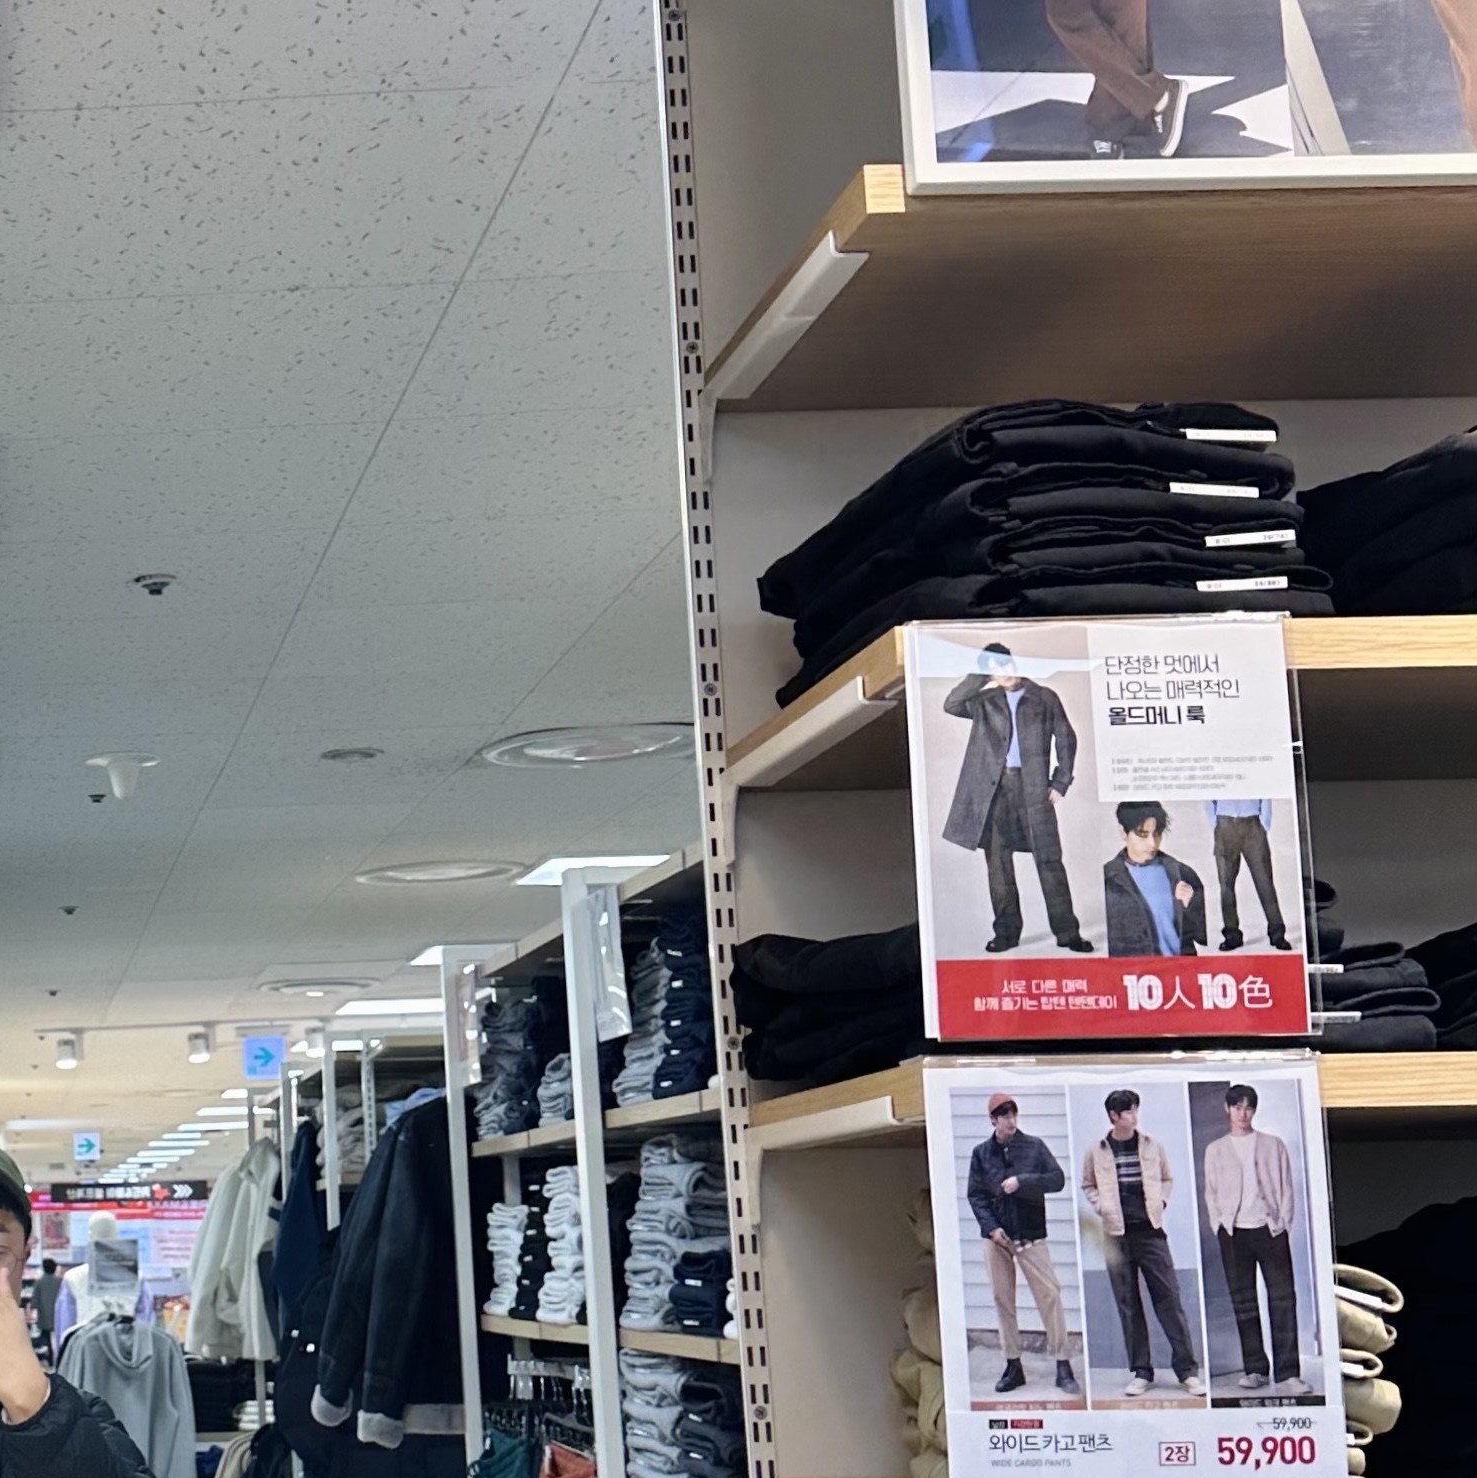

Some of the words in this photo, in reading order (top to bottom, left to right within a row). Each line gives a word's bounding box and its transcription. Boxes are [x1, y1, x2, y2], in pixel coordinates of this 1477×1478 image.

[1105, 655, 1160, 675] 단정한
[1164, 653, 1220, 675] 멋에서
[1107, 680, 1162, 700] 나오는
[1166, 679, 1240, 700] 매력적인
[1109, 705, 1182, 726] 올드머니
[1186, 705, 1206, 725] 룩
[1001, 980, 1027, 994] 서로
[1032, 980, 1057, 994] 다른
[1123, 973, 1273, 1010] 10人10色
[1001, 996, 1039, 1011] 즐기는
[1273, 1417, 1312, 1431] 59,900
[989, 1434, 1040, 1453] 와이드
[1042, 1434, 1077, 1453] 카고
[1078, 1433, 1114, 1452] 팬츠
[991, 1459, 1012, 1468] WIDE
[1044, 1459, 1072, 1467] PANTS
[1164, 1445, 1191, 1463] 2장
[1217, 1436, 1316, 1471] 59,900
